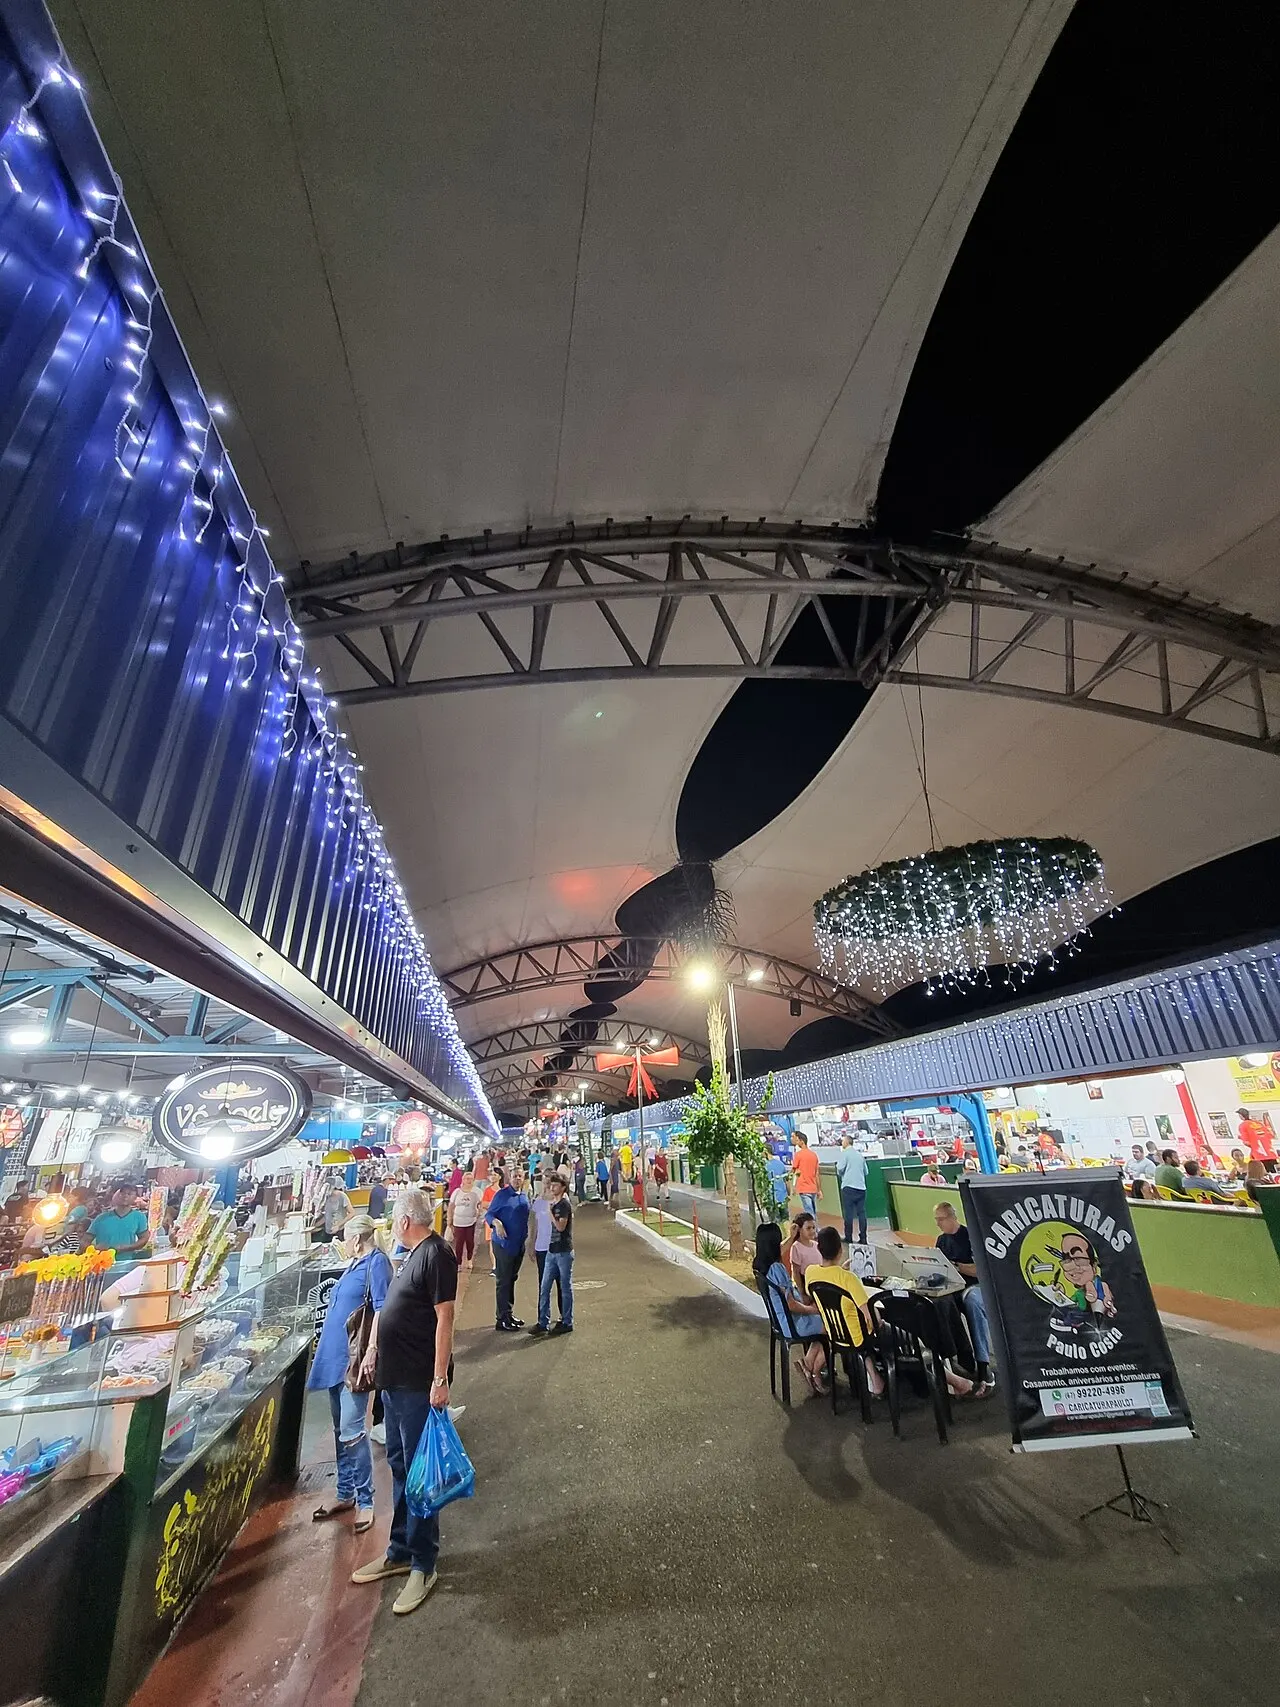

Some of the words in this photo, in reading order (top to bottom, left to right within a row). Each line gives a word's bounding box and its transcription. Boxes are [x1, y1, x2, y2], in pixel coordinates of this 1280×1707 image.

[985, 1194, 1132, 1259] CARICATURAS
[1046, 1333, 1087, 1360] Paulo
[1089, 1327, 1124, 1358] Costa
[1022, 1379, 1067, 1390] Casamento,
[1067, 1374, 1114, 1386] aniversários
[1120, 1372, 1161, 1382] formaturas
[1040, 1367, 1089, 1377] Trabalhamos
[1090, 1366, 1106, 1374] com
[1107, 1363, 1138, 1373] eventos:
